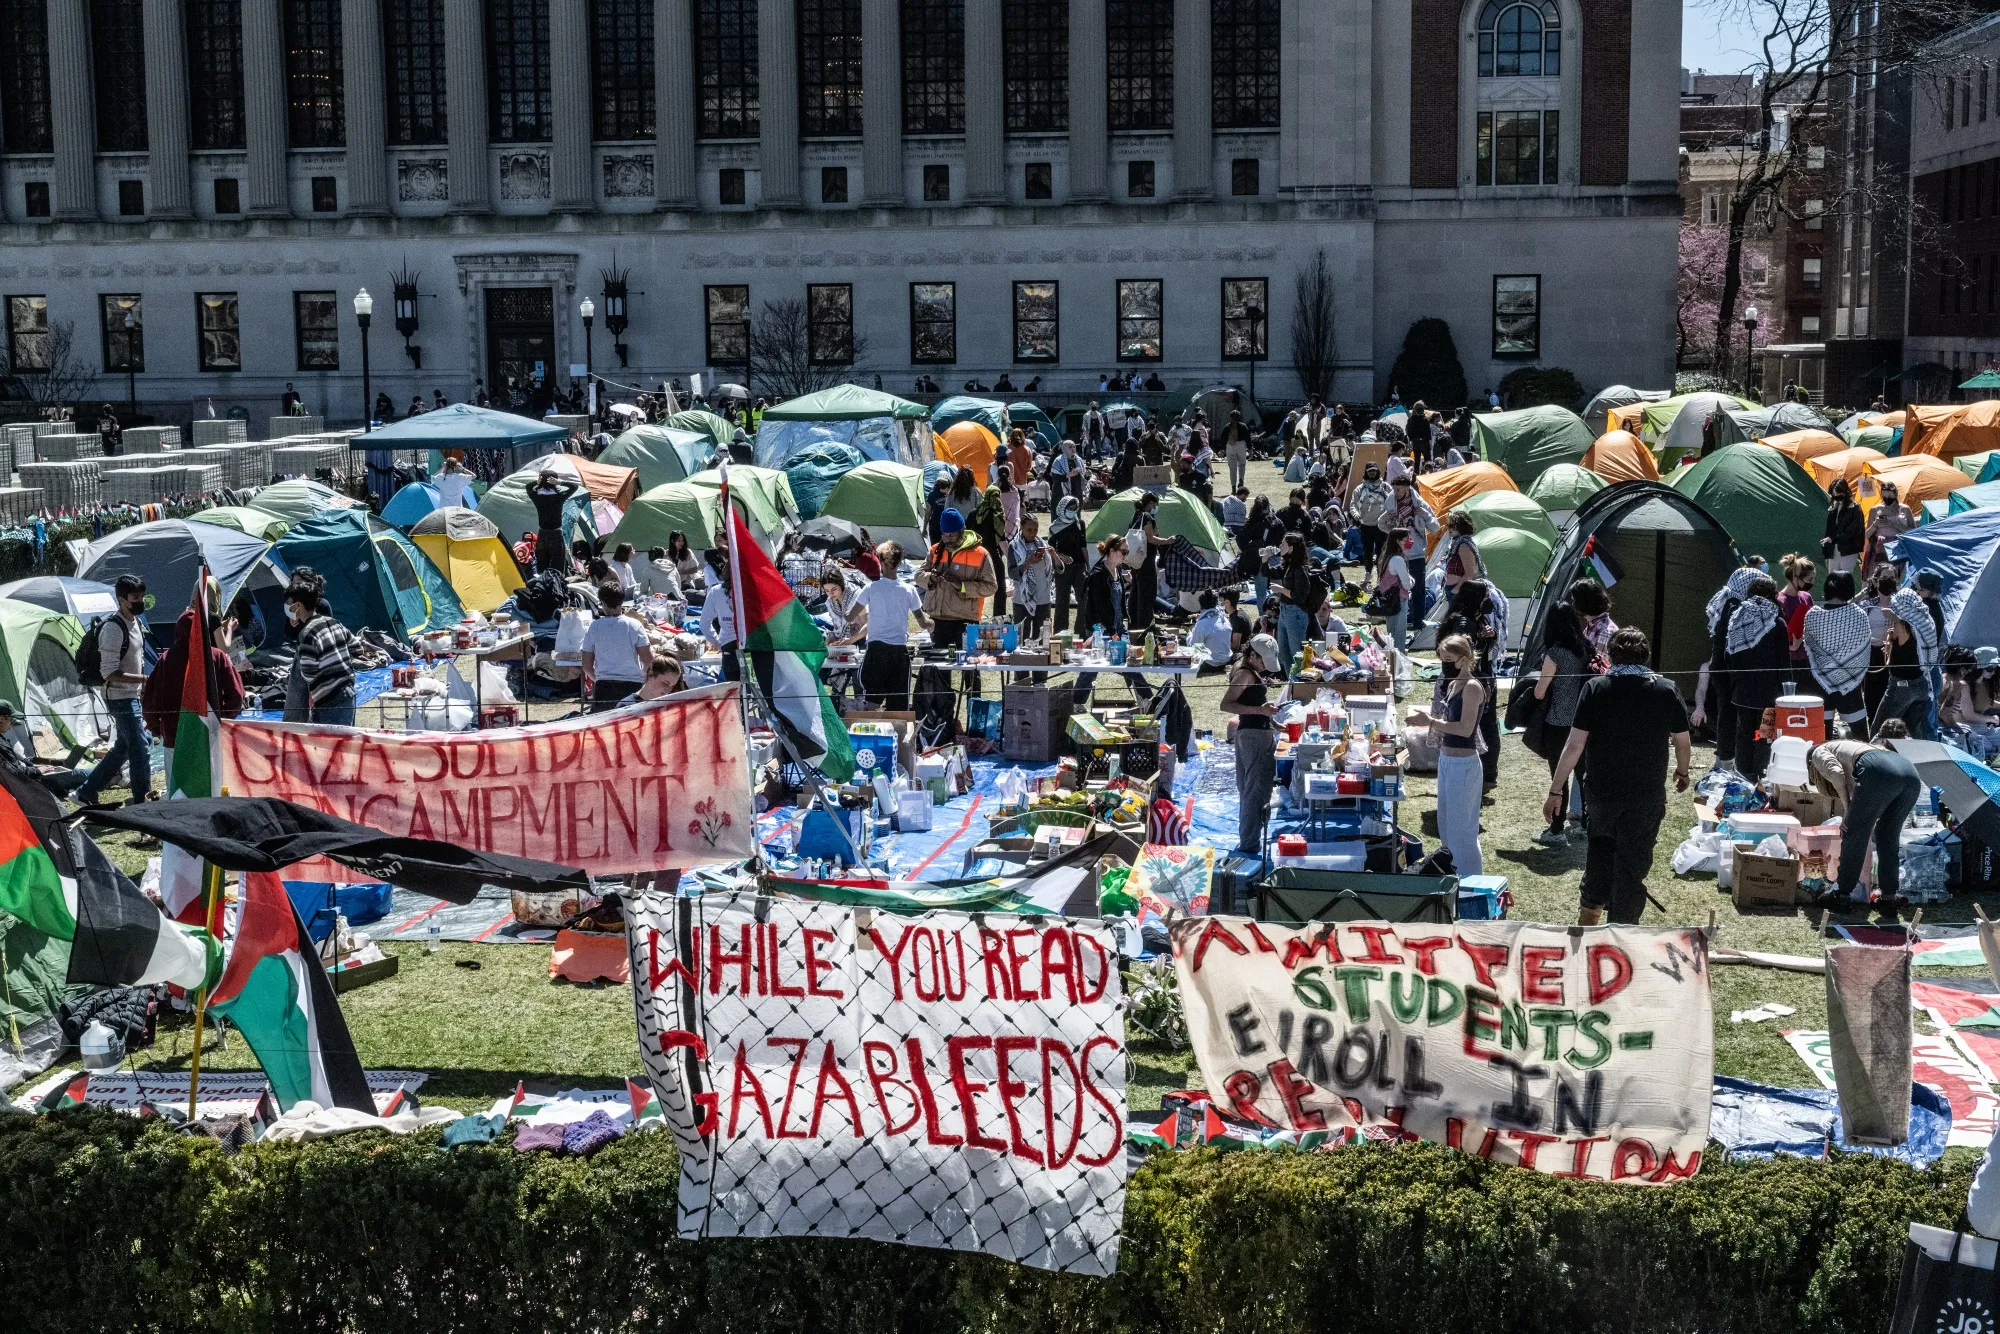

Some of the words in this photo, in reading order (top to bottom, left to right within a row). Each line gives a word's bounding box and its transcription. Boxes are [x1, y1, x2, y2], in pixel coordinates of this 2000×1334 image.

[230, 723, 405, 786] GAZA
[412, 688, 736, 783] SOLIDARITY
[648, 923, 844, 999] WHILE
[868, 924, 968, 1002] YOU
[979, 927, 1109, 1004] READ
[1487, 1054, 1609, 1136] IN
